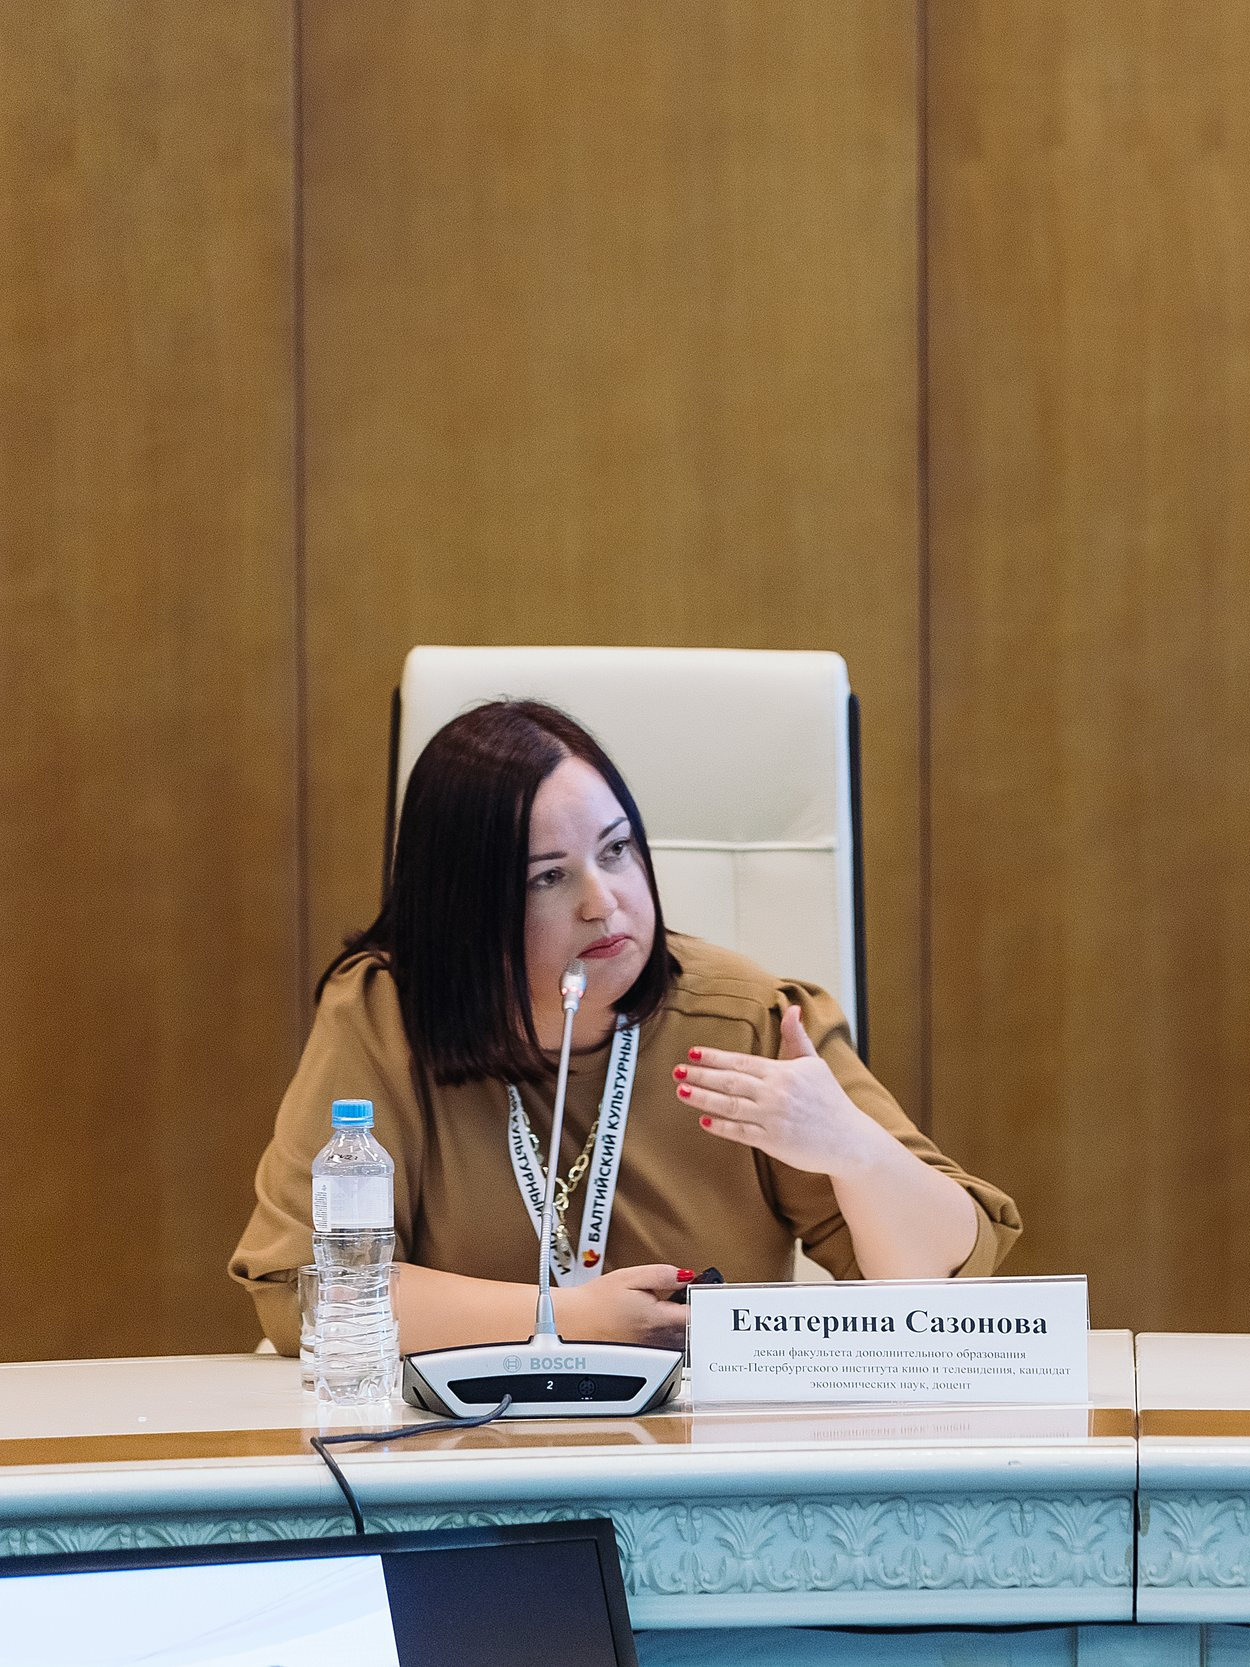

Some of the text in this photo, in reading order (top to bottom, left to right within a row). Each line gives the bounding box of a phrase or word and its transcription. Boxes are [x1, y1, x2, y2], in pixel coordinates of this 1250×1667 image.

[588, 1134, 617, 1243] БАЛТИЙСКИЙ
[730, 1308, 1048, 1338] Екатерина Сазонова
[753, 1347, 1027, 1361] декан факультета дополнительного образования
[530, 1357, 586, 1370] BOSCH
[709, 1362, 1072, 1376] Санкт-Петербургского института кино и телевидения, кандидат
[546, 1380, 554, 1390] 2
[810, 1380, 972, 1391] экономических наук, доцент
